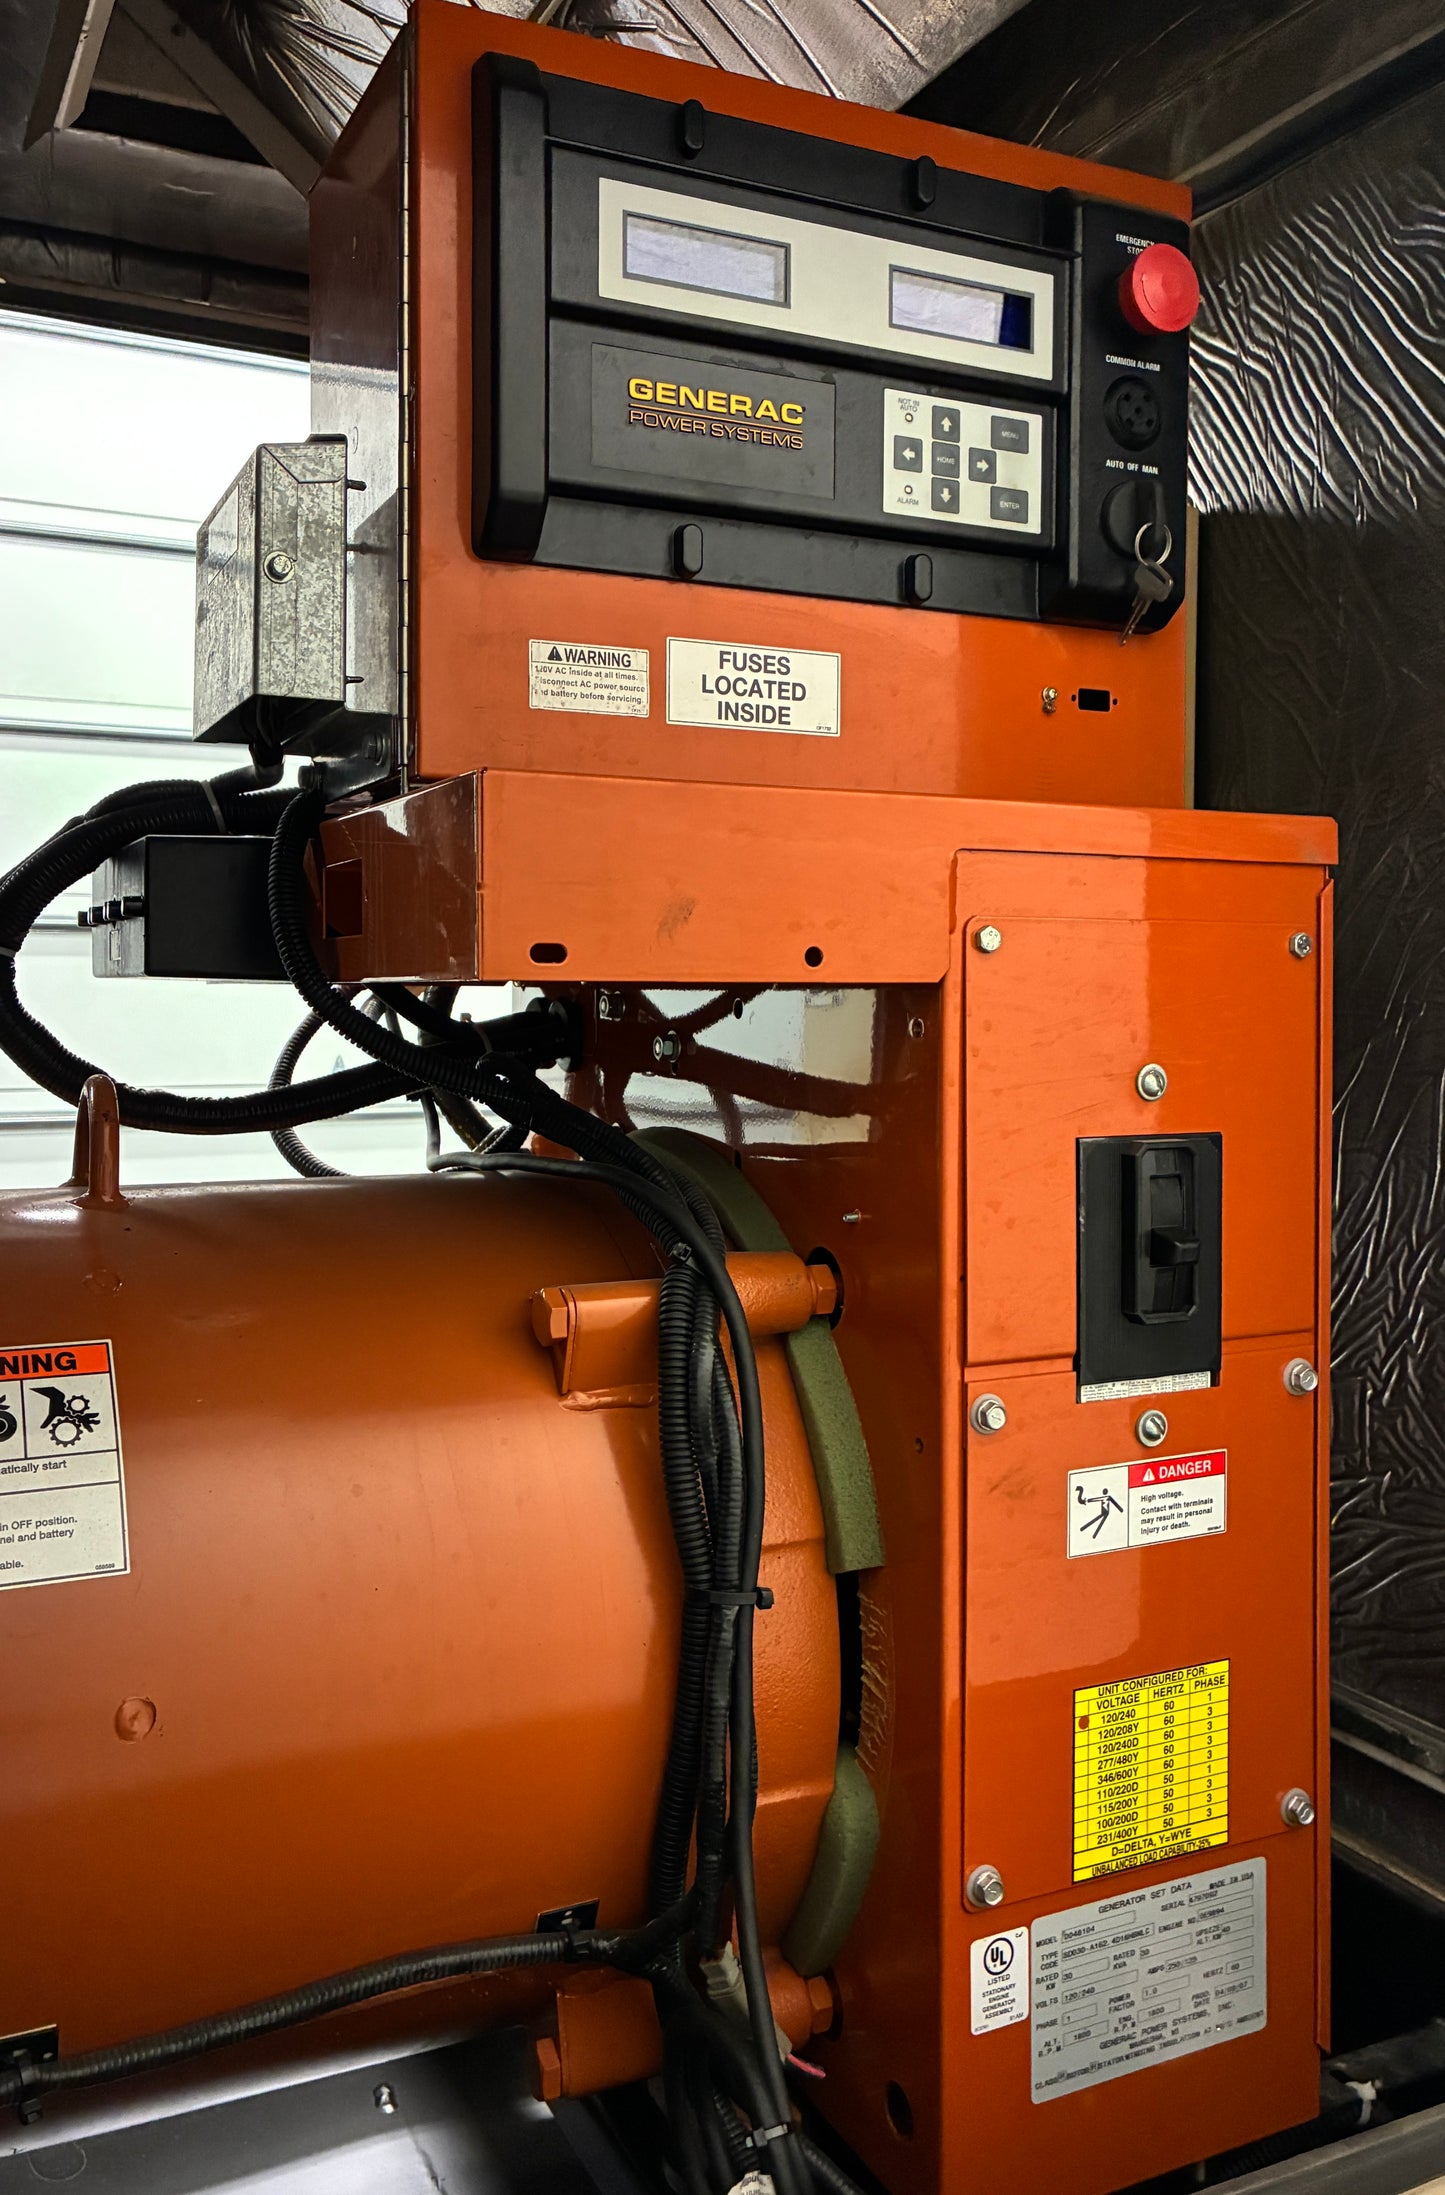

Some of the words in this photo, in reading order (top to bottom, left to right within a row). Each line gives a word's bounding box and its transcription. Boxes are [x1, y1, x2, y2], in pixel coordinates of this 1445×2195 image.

[1105, 354, 1136, 368] COMMON
[1137, 360, 1160, 372] ALARM
[628, 378, 803, 425] GENERAC
[898, 397, 912, 406] NOT
[900, 404, 918, 413] AUTO
[629, 410, 706, 435] POWER
[710, 422, 803, 450] SYSTEMS
[1001, 430, 1019, 440] MENU
[936, 456, 955, 465] HOME
[1105, 459, 1124, 470] AUTO
[1127, 462, 1139, 472] OFF
[1142, 465, 1159, 475] MAN
[897, 497, 919, 506] ALARM
[1000, 501, 1020, 510] ENTER
[564, 648, 632, 668] WARNING
[719, 650, 791, 676] FUSES
[555, 666, 567, 675] AC
[594, 670, 603, 678] at
[615, 673, 639, 681] times.
[593, 683, 617, 692] power
[619, 685, 645, 693] source
[701, 674, 807, 702] LOCATED
[551, 690, 578, 700] battery
[580, 691, 605, 701] before
[607, 693, 644, 705] servicing.
[717, 701, 791, 726] INSIDE
[42, 1460, 67, 1471] start
[1159, 1460, 1212, 1479] DANGER
[1140, 1494, 1157, 1503] High
[1158, 1490, 1184, 1501] voltage.
[1140, 1505, 1167, 1515] Contact
[1167, 1502, 1182, 1511] with
[1183, 1497, 1214, 1509] terminals
[11, 1519, 33, 1530] OFF
[35, 1515, 78, 1529] position.
[1140, 1517, 1154, 1526] may
[1156, 1513, 1175, 1523] result
[1176, 1511, 1183, 1519] in
[1184, 1507, 1213, 1519] personal
[1170, 1521, 1191, 1530] death.
[17, 1532, 37, 1542] and
[39, 1529, 75, 1540] battery
[1098, 1684, 1120, 1697] UNIT
[1122, 1671, 1184, 1692] CONFIGURED
[1186, 1667, 1208, 1679] FOR:
[1096, 1693, 1141, 1711] VOLTAGE
[1153, 1684, 1184, 1699] HERTZ
[1194, 1675, 1225, 1690] PHASE
[1101, 1709, 1136, 1725] 120/240
[1163, 1700, 1175, 1710] 60
[1098, 1722, 1139, 1740] 120/208Y
[1163, 1715, 1175, 1725] 60
[1207, 1706, 1213, 1716] 3
[1097, 1737, 1139, 1755] 120/240D
[1163, 1729, 1175, 1739] 60
[1207, 1721, 1213, 1731] 3
[1097, 1752, 1139, 1770] 277/480Y
[1163, 1744, 1175, 1754] 60
[1207, 1735, 1213, 1745] 3
[1097, 1767, 1139, 1785] 346/600Y
[1163, 1758, 1175, 1769] 60
[1207, 1750, 1213, 1760] 3
[1097, 1782, 1139, 1800] 110/220D
[1163, 1774, 1175, 1784] 50
[1097, 1796, 1139, 1814] 115/200Y
[1163, 1788, 1175, 1799] 50
[1207, 1779, 1213, 1789] 3
[1097, 1811, 1139, 1829] 100/200D
[1163, 1803, 1175, 1813] 50
[1207, 1793, 1213, 1803] 3
[1097, 1826, 1139, 1845] 231/400Y
[1163, 1817, 1175, 1828] 50
[1207, 1808, 1213, 1817] 3
[1111, 1840, 1157, 1857] D=DELTA,
[1159, 1828, 1192, 1844] Y=WYE
[1092, 1857, 1138, 1877] UNBALANCED
[1139, 1851, 1158, 1865] LOAD
[1209, 1879, 1226, 1890] MADE
[1229, 1876, 1239, 1884] IN
[1241, 1872, 1254, 1882] USA
[1098, 1894, 1146, 1914] GENERATOR
[1150, 1888, 1167, 1899] SET
[1170, 1882, 1192, 1894] DATA
[1161, 1900, 1186, 1912] SERIAL
[1158, 1920, 1183, 1933] ENGINE
[1035, 1936, 1058, 1948] MODEL
[990, 1946, 1007, 1966] UL
[1041, 1950, 1059, 1961] TYPE
[1113, 1949, 1136, 1961] RATED
[1040, 1960, 1059, 1971] CODE
[1202, 1966, 1224, 1979] HERTZ
[987, 1973, 1011, 1986] LISTED
[1035, 1972, 1059, 1985] RATED
[1064, 1972, 1073, 1981] 30
[981, 1983, 1016, 1998] STATIONARY
[988, 1992, 1010, 2004] ENGINE
[982, 1998, 1016, 2013] GENERATOR
[1035, 1997, 1059, 2010] VOLTS
[1108, 1993, 1131, 2005] POWER
[1193, 1997, 1210, 2009] DATE
[984, 2006, 1014, 2020] ASSEMBLY
[1108, 2000, 1136, 2014] FACTOR
[1035, 2018, 1058, 2031] PHASE
[1098, 2031, 1137, 2050] GENERAC
[1141, 2022, 1168, 2036] POWER
